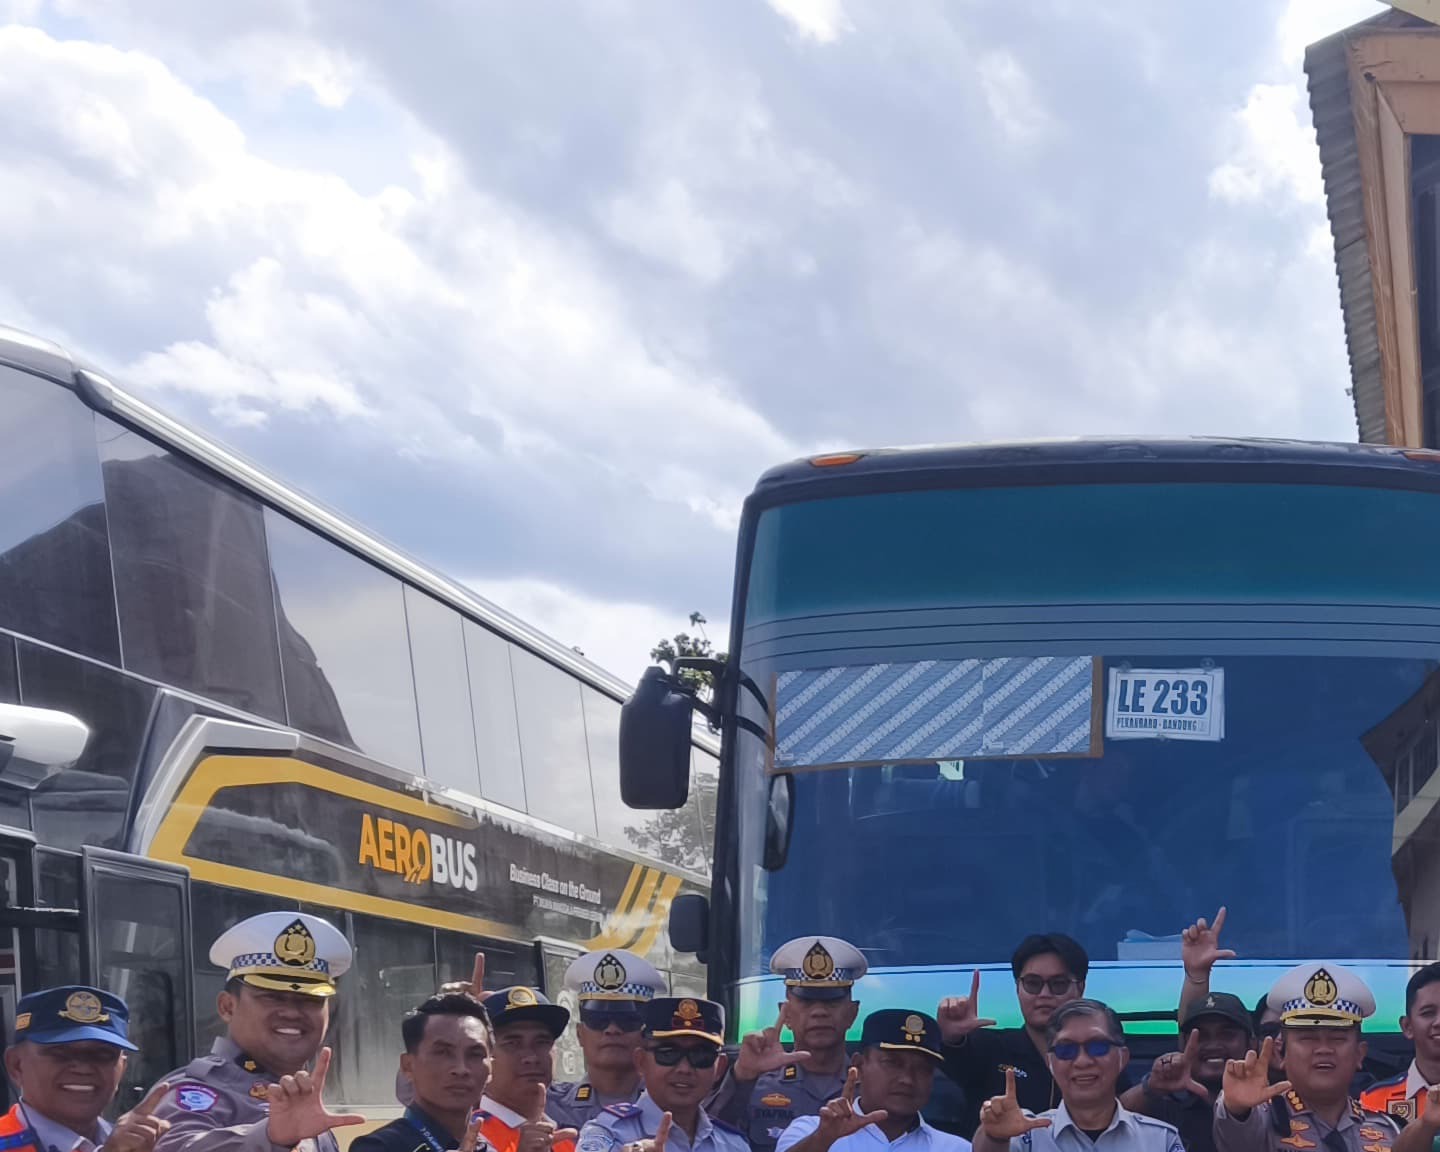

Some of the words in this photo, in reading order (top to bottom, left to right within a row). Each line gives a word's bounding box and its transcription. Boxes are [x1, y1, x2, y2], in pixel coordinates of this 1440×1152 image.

[1118, 679, 1147, 713] LE
[1152, 679, 1208, 715] 233
[359, 813, 478, 892] AEROBUS
[510, 863, 540, 889] Business
[541, 872, 560, 894] Class
[579, 883, 601, 905] Ground
